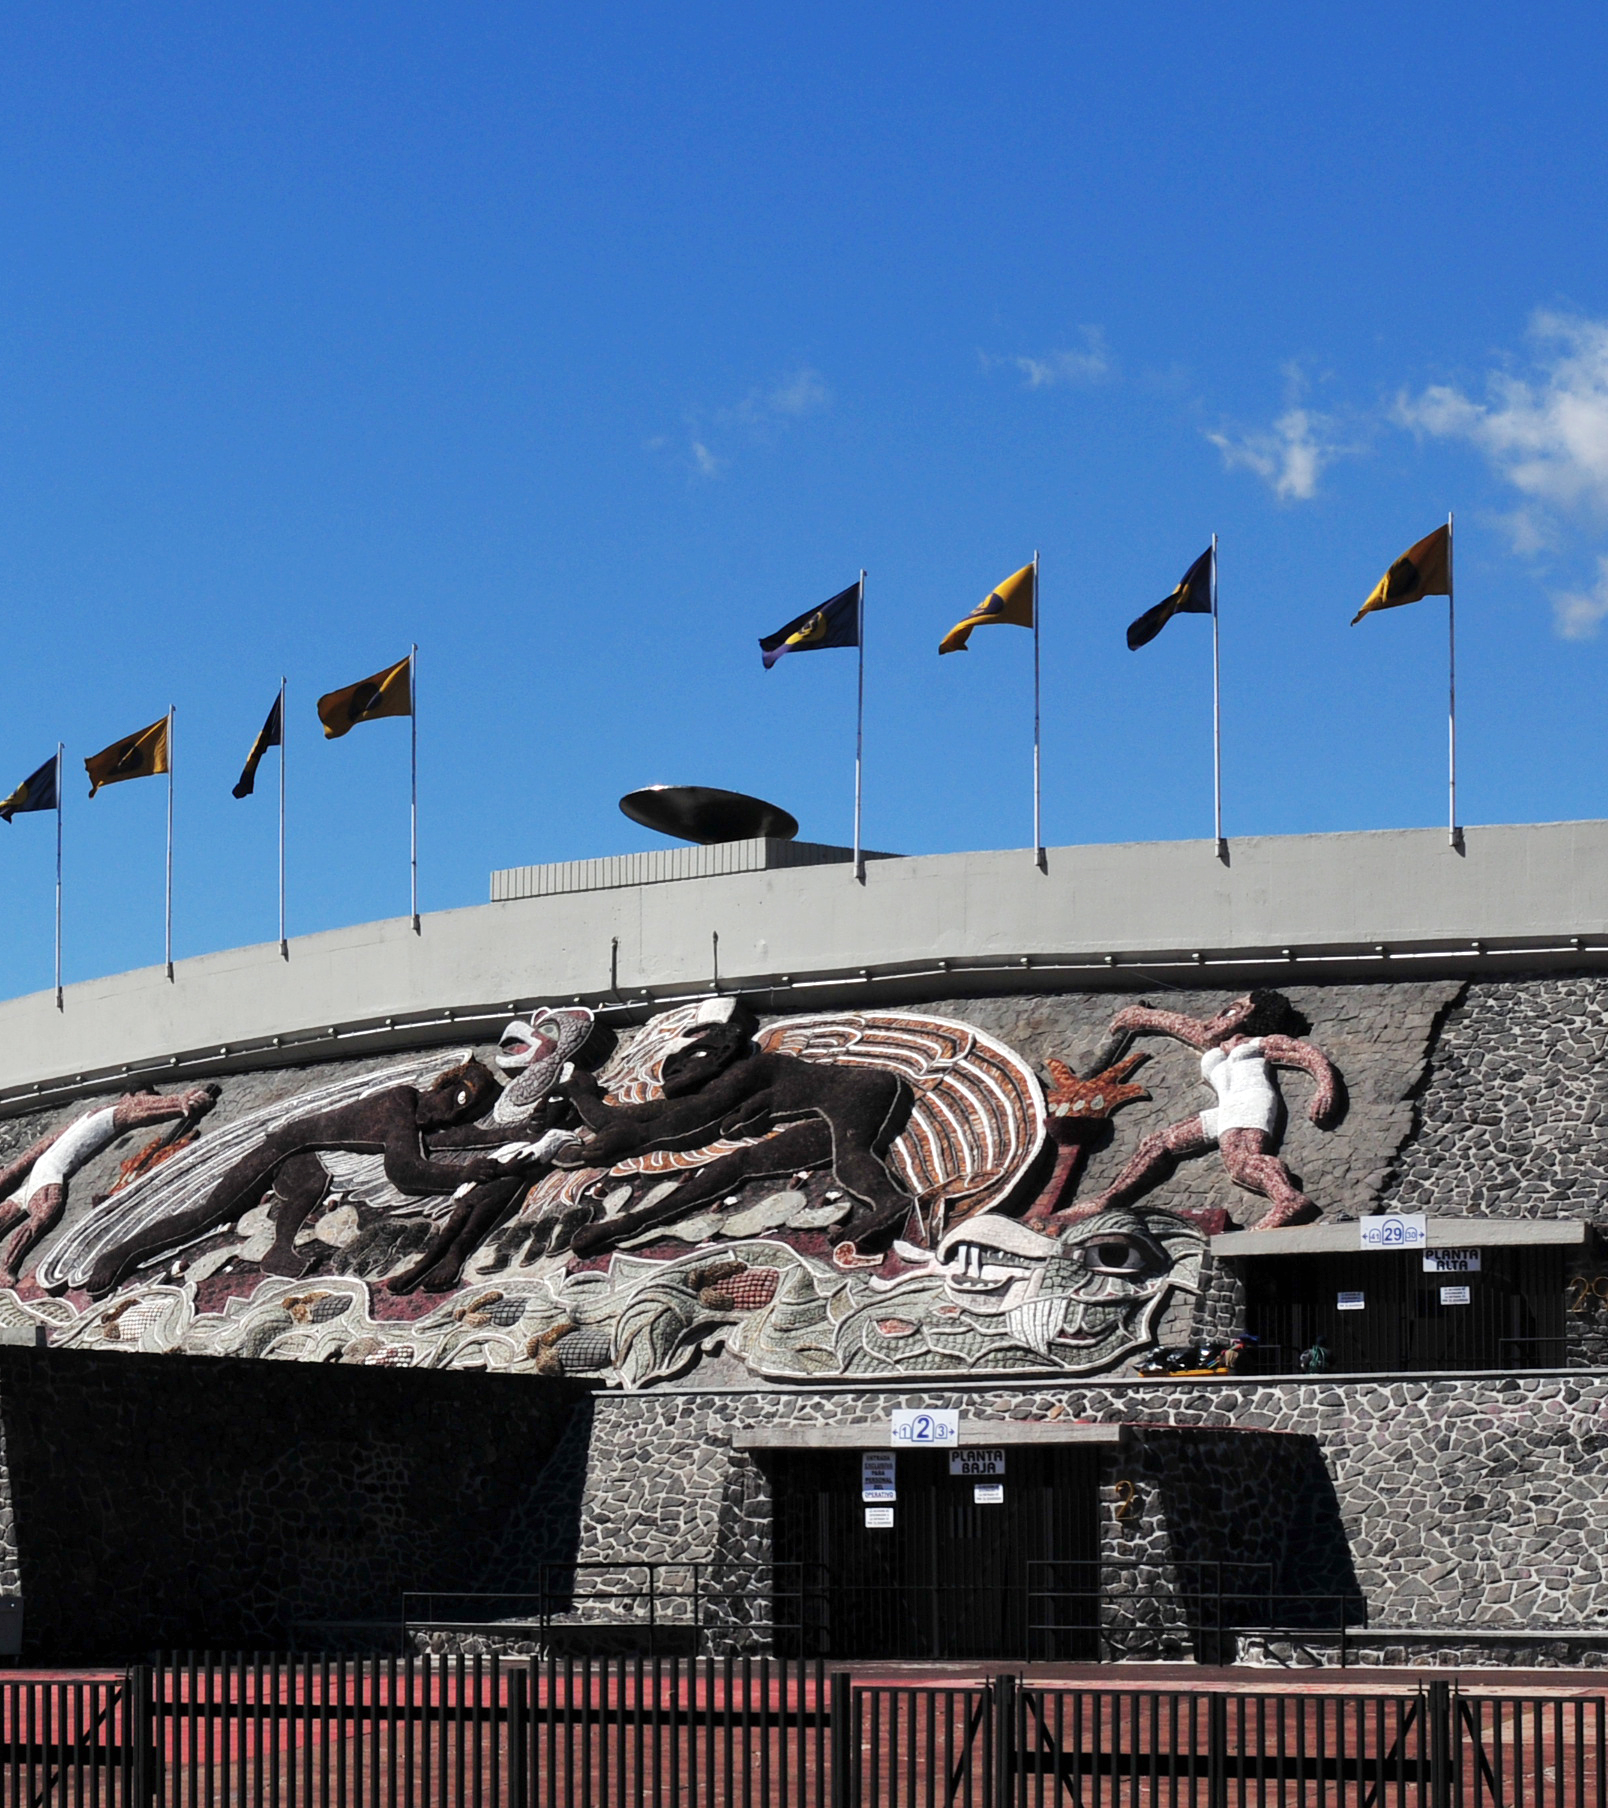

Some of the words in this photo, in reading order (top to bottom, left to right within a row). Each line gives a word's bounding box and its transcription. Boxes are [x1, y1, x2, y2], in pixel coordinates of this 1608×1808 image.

[1384, 1227, 1402, 1241] 29
[1406, 1231, 1416, 1239] 30
[1425, 1250, 1479, 1260] PLANTA
[1436, 1260, 1468, 1271] ALTA
[902, 1427, 906, 1438] 1
[917, 1417, 930, 1439] 2
[938, 1425, 945, 1437] 3
[952, 1451, 1003, 1462] PLANTA
[962, 1462, 996, 1474] BAJA
[865, 1491, 894, 1499] OPERATIVO
[1115, 1480, 1135, 1520] 2
